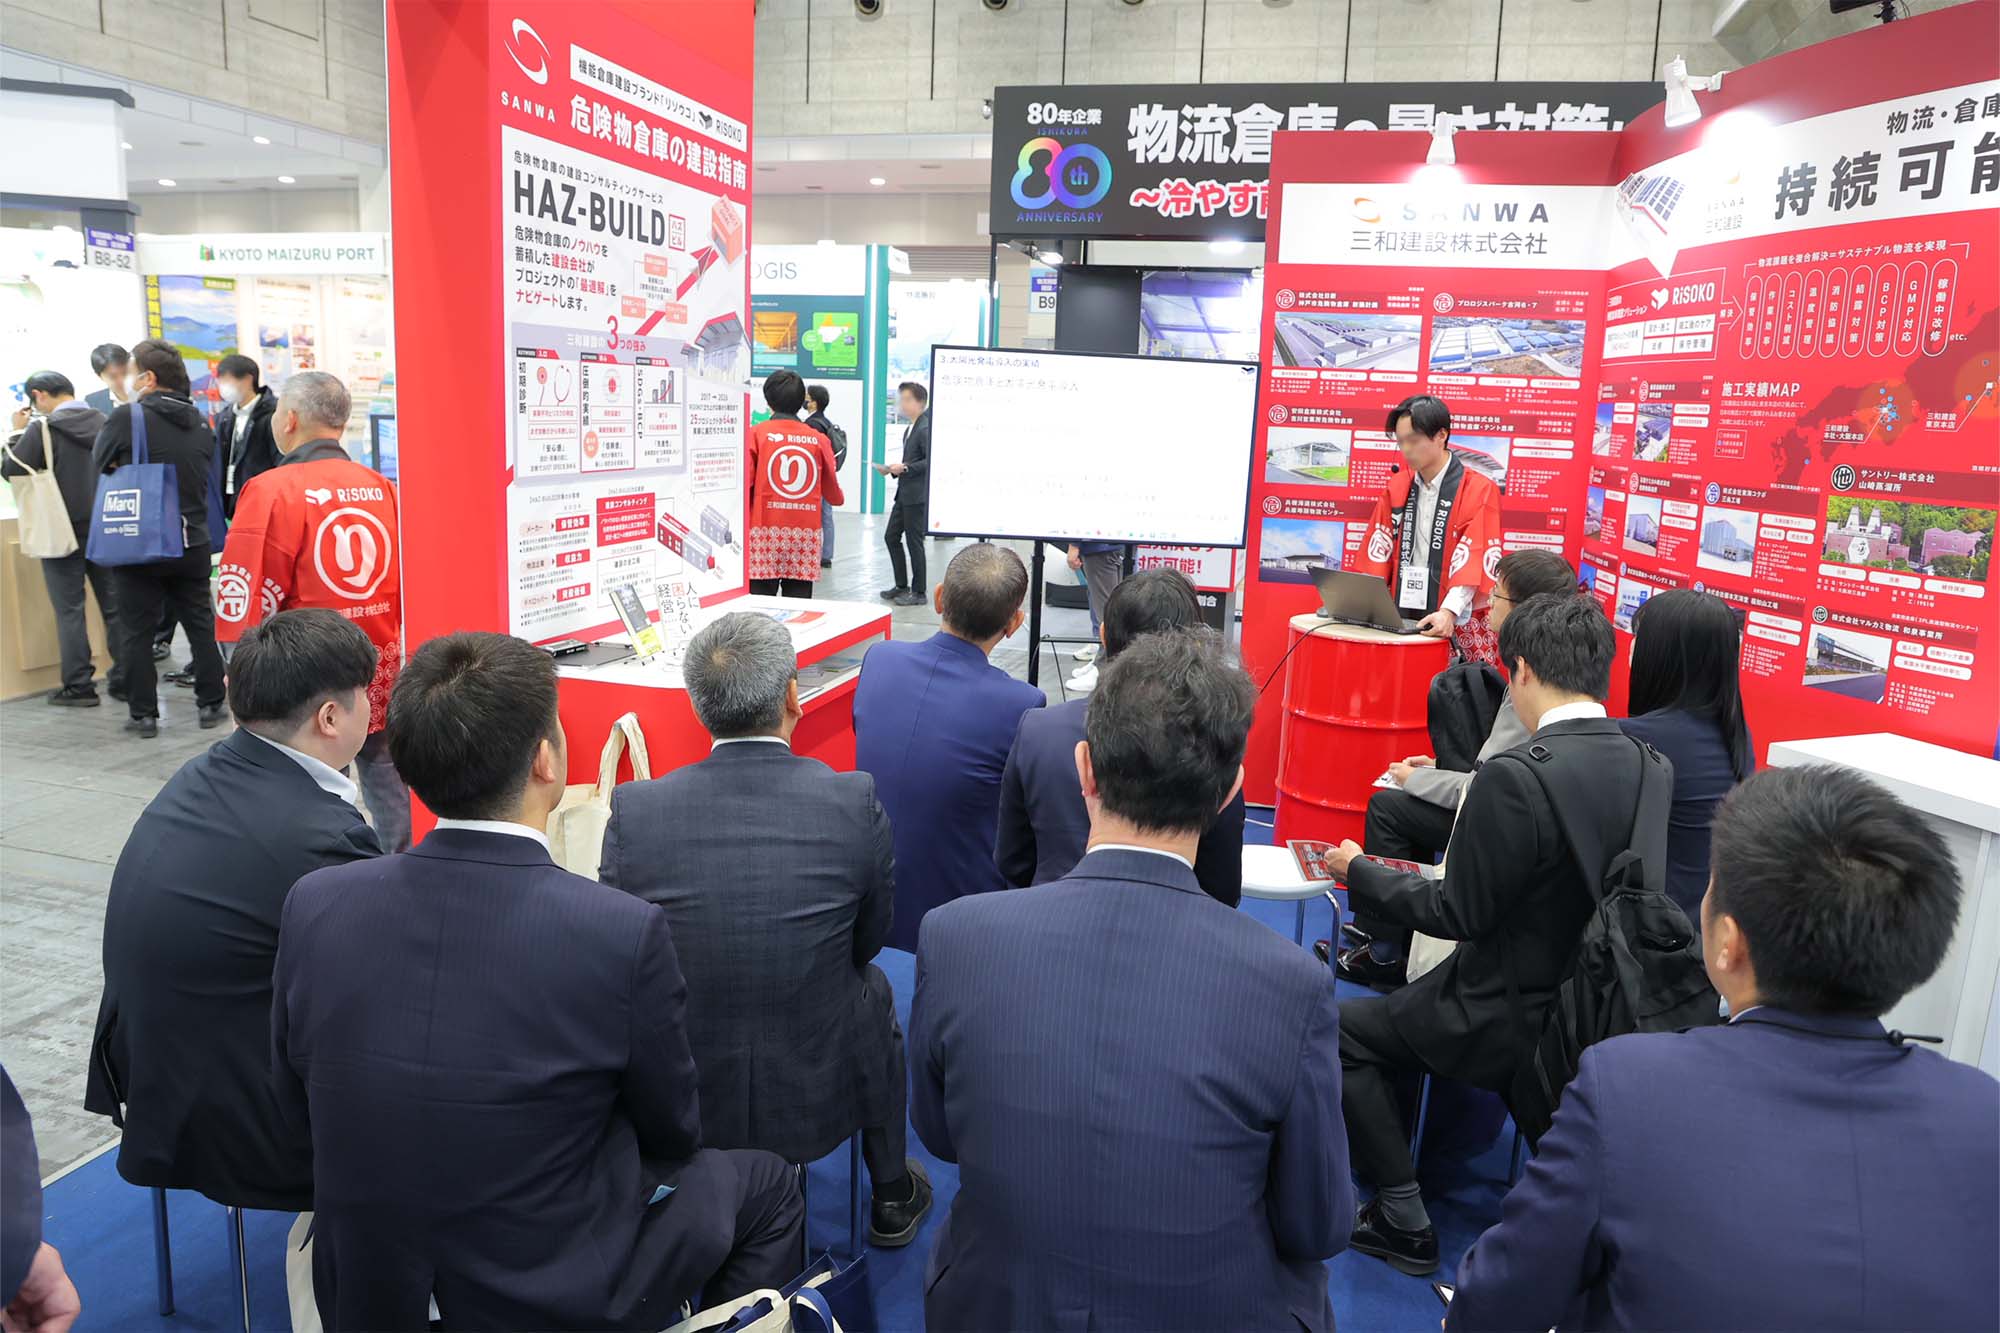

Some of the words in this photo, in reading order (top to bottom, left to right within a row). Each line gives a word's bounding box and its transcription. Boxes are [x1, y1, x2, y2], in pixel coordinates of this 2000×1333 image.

[501, 91, 556, 123] SANWA
[1027, 102, 1102, 125] 80年企業
[570, 94, 747, 190] 危険物倉庫の建設指南
[1037, 127, 1088, 136] ISHIKURA
[514, 170, 665, 247] HAZ-BUILD
[1017, 212, 1103, 223] ANNIVERSARY
[515, 225, 608, 258] 危険物倉庫のノウハウを
[1350, 231, 1548, 255] 三和建設株式会社
[95, 252, 131, 269] B8-52
[219, 248, 262, 261] KYOTO
[267, 248, 331, 261] MAIZURU
[337, 247, 375, 260] PORT
[515, 246, 595, 273] 蓄積した建設会社が
[516, 288, 587, 312] ナビゲートします。
[1722, 381, 1800, 397] 施工実績MAP
[1861, 470, 1935, 484] サントリー株式会社
[337, 487, 383, 503] RiSOKO
